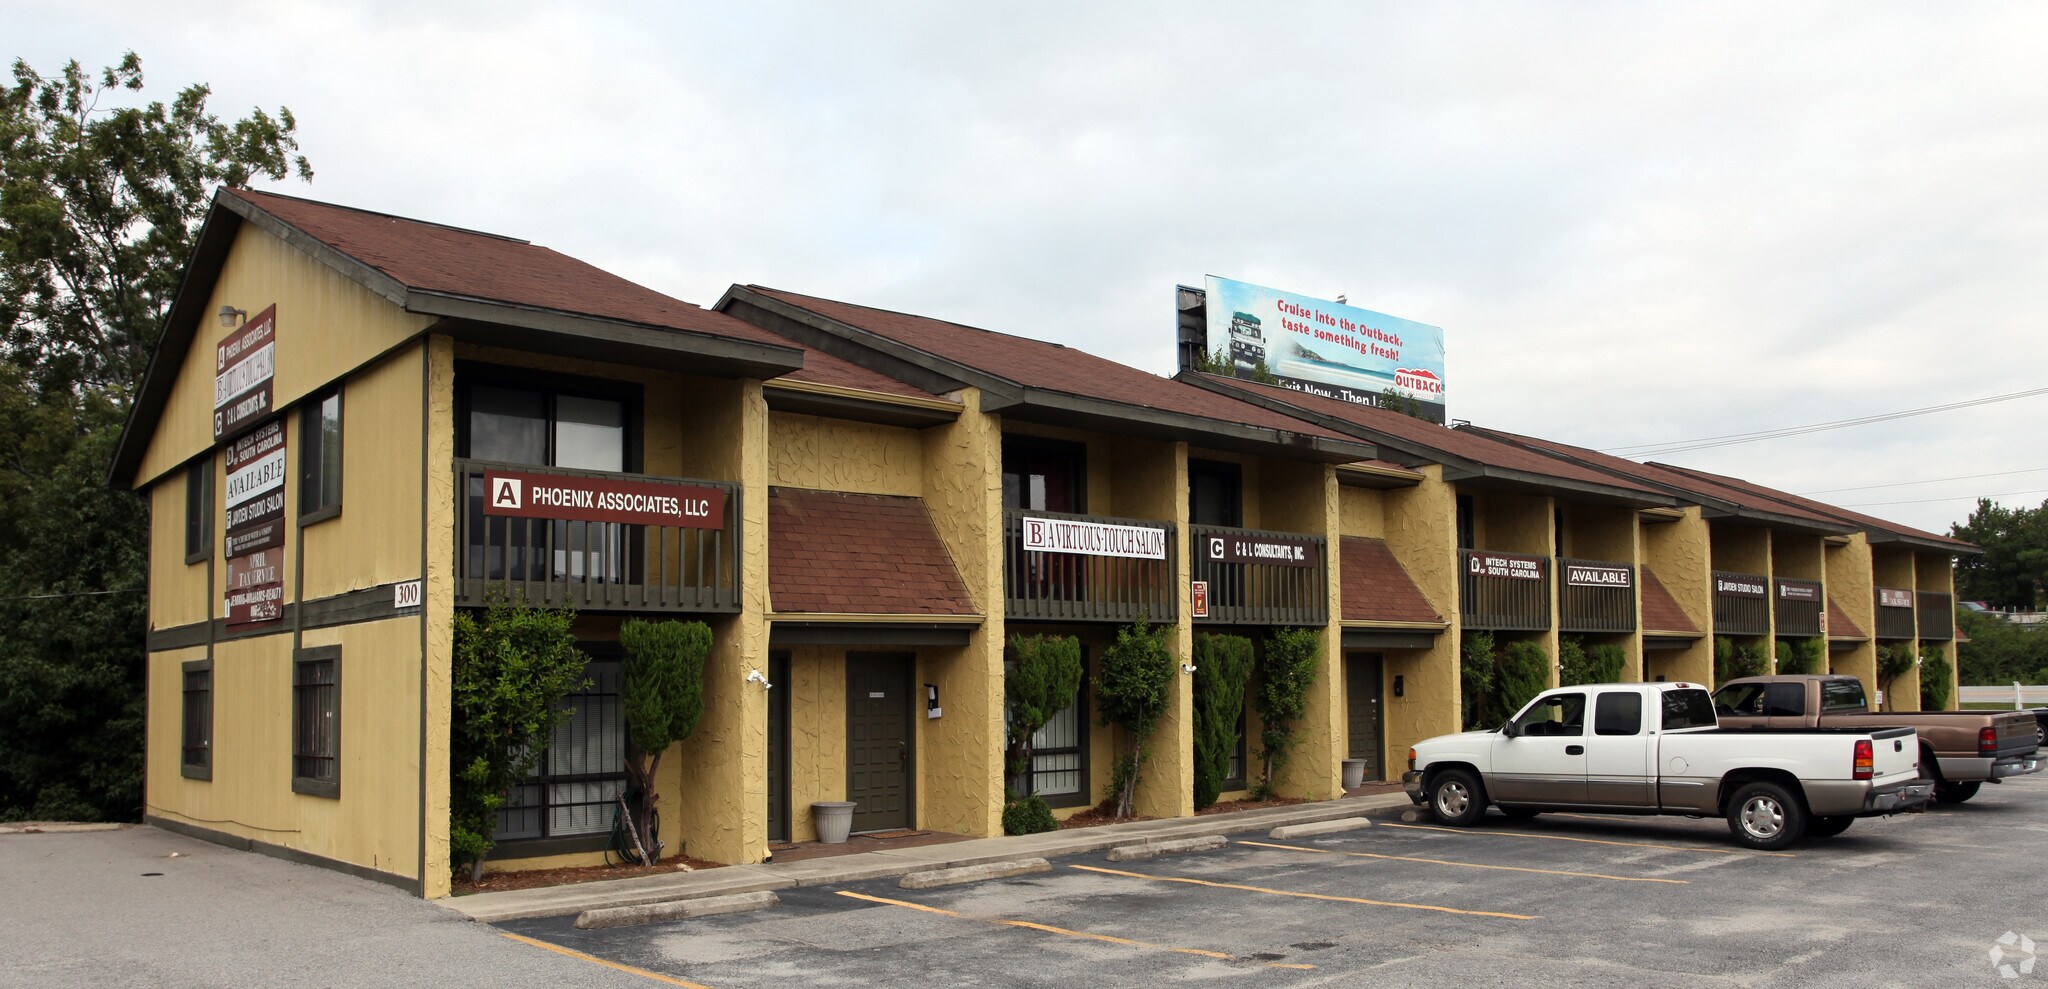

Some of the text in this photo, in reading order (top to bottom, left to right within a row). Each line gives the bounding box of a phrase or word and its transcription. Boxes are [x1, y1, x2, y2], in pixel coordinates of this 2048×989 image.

[1277, 299, 1403, 347] Cruise into the Outback,
[1281, 317, 1399, 361] taste something fresh!
[1395, 375, 1441, 393] OUTBACK
[239, 445, 256, 463] SOUTH
[256, 431, 283, 454] CAROLINA
[227, 458, 283, 500] AVAILABLE
[248, 499, 265, 520] STUDIO
[266, 491, 283, 513] SALON
[496, 481, 709, 518] A PHOENIX ASSOCIATES, LLC
[1030, 522, 1043, 545] B
[1048, 522, 1055, 548] A
[1212, 540, 1223, 556] C
[1235, 541, 1241, 556] C
[1485, 557, 1508, 567] INTECH
[1509, 559, 1537, 570] SYSTEMS
[1488, 567, 1509, 577] SOUTH
[1510, 569, 1540, 579] CAROLINA
[1571, 570, 1627, 584] AVAILABLE
[398, 584, 418, 604] 300
